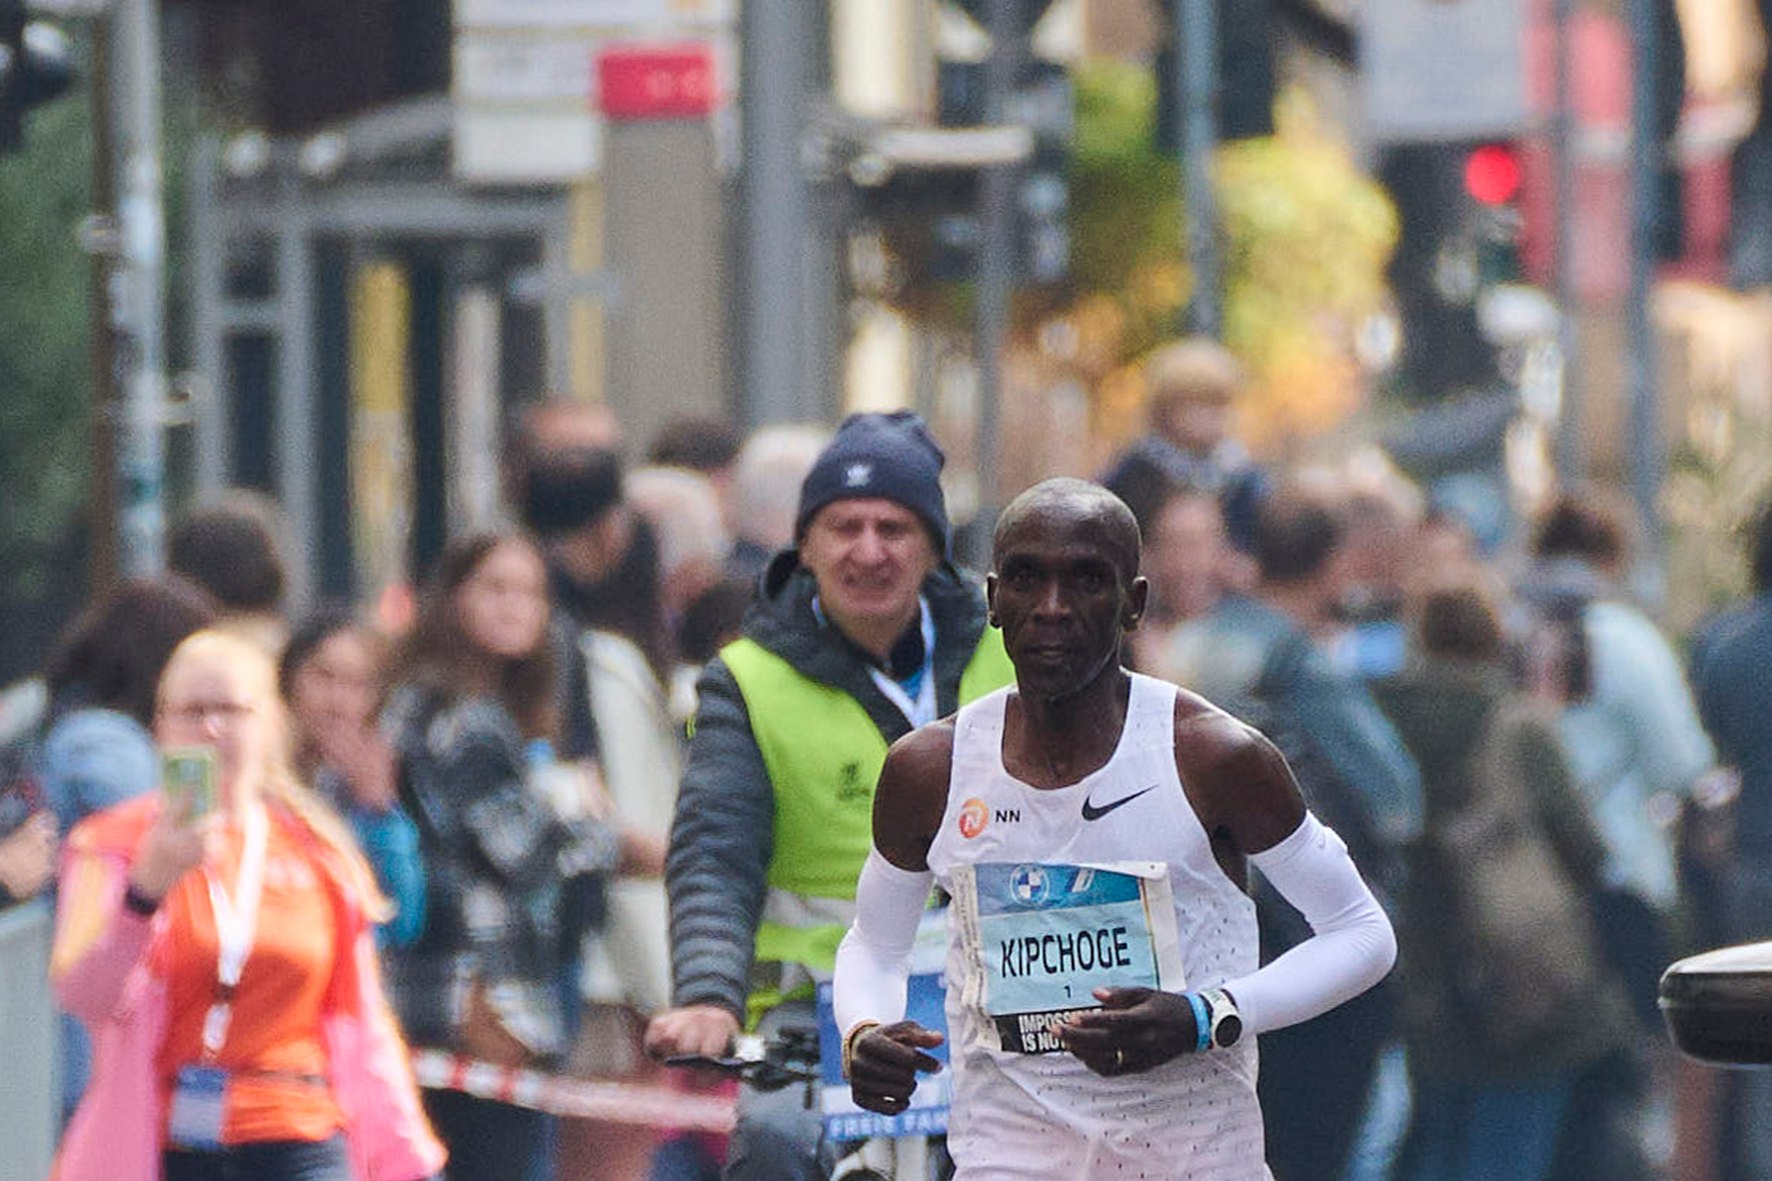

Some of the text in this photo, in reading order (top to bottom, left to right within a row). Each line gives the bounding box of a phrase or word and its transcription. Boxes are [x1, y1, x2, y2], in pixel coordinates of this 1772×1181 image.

[995, 809, 1021, 823] NN
[1001, 926, 1131, 979] KIPCHOGE
[1064, 985, 1072, 999] 1
[1022, 1032, 1037, 1052] IS
